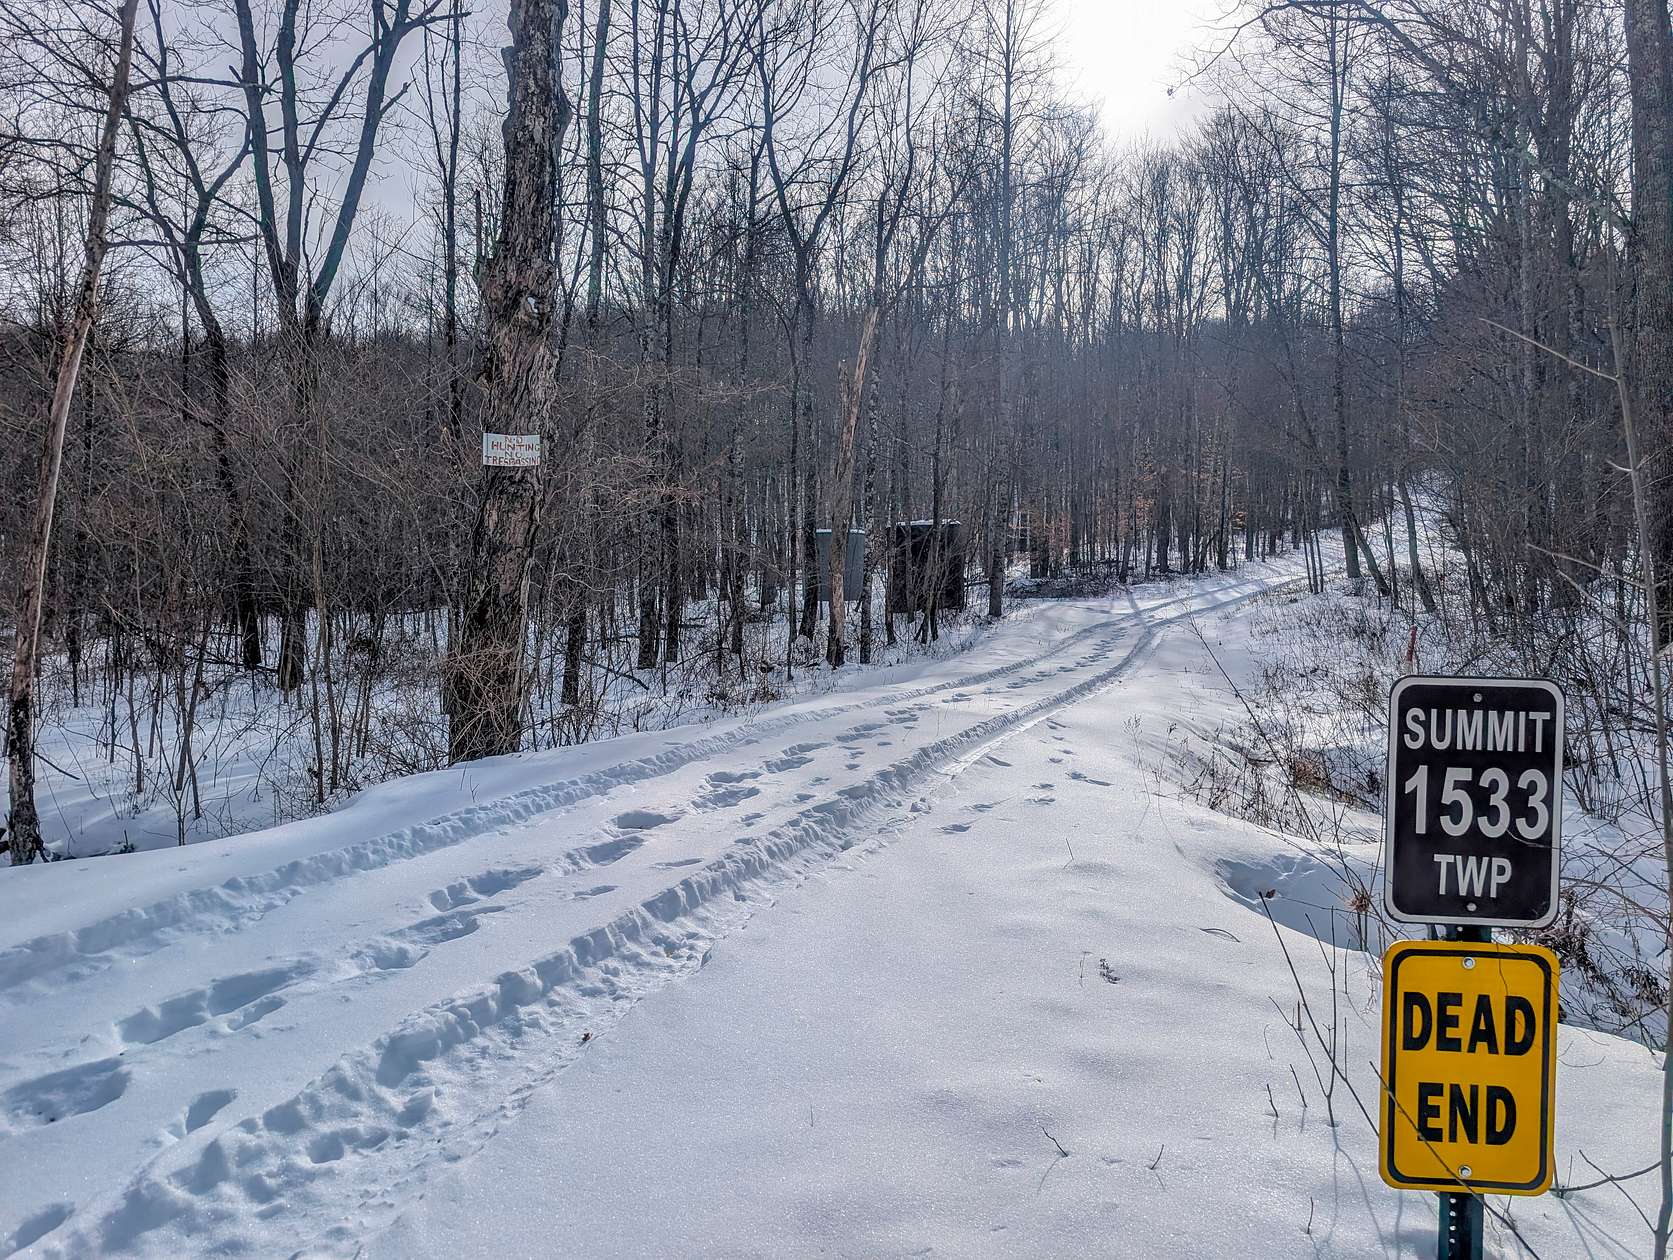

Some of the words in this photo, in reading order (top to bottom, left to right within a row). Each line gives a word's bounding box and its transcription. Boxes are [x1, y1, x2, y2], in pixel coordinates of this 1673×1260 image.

[491, 441, 541, 451] HUNTING
[1403, 707, 1551, 753] SUMMIT
[1404, 765, 1550, 840] 1533
[1433, 853, 1512, 898] TWP
[1402, 991, 1537, 1057] DEAD
[1417, 1081, 1517, 1146] END
